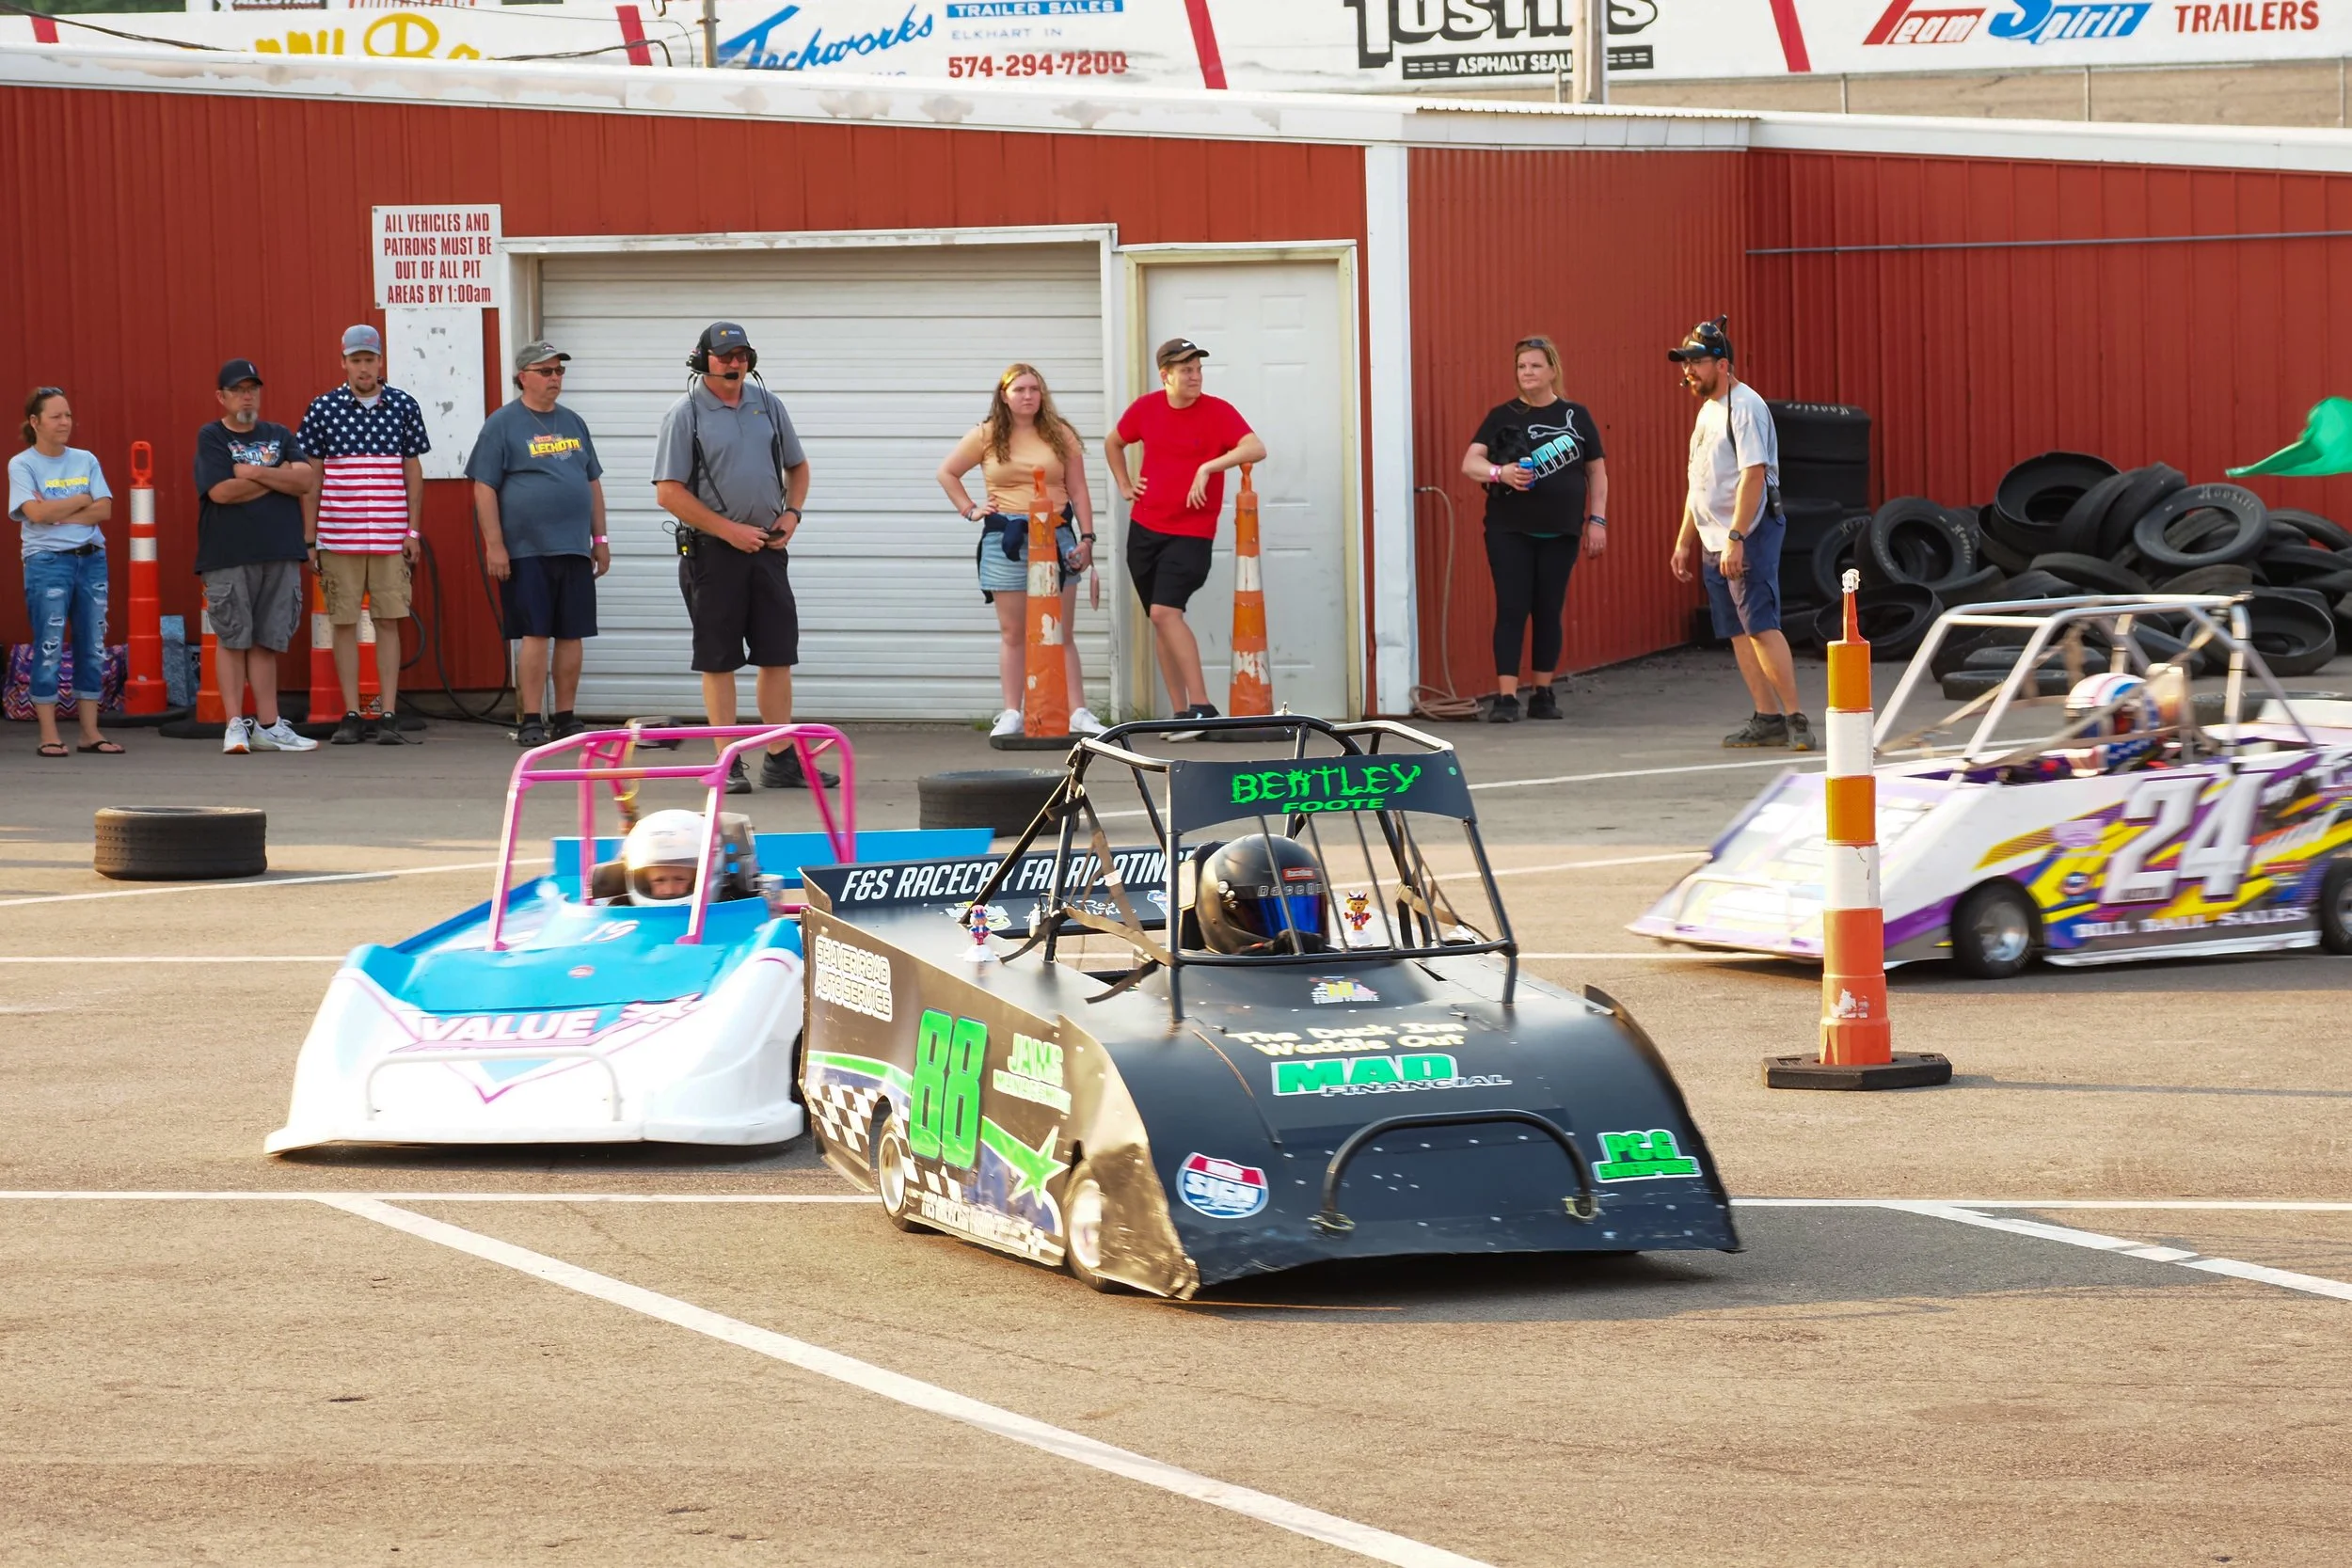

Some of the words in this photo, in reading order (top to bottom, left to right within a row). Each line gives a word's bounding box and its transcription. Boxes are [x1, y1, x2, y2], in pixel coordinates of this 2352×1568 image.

[955, 3, 1041, 17] TRAILER
[1048, 0, 1116, 14] SALES
[2174, 0, 2320, 35] TRAILERS
[951, 27, 1032, 40] ELKHART
[1043, 27, 1062, 38] IN
[948, 50, 1128, 79] 574-294-7200
[1456, 54, 1527, 74] ASPHALT
[385, 214, 404, 232] ALL
[407, 213, 461, 232] VEHICLES
[466, 213, 490, 232] AND
[384, 237, 437, 257] PATRONS
[441, 236, 473, 256] MUST
[478, 236, 492, 255] BE
[395, 261, 417, 279] OUT
[421, 261, 435, 279] OF
[439, 260, 458, 279] ALL
[463, 260, 482, 278] PIT
[388, 285, 424, 304] AREAS
[429, 284, 443, 303] BY
[448, 284, 491, 303] 1:00am
[1231, 764, 1422, 803] BENTLEY
[1282, 798, 1386, 813] FOOTE
[2100, 773, 2274, 903] 24
[840, 868, 894, 902] F&S
[421, 1009, 601, 1041] VALUE
[1225, 1031, 1302, 1043] The
[1307, 1023, 1399, 1038] Duck
[1252, 1037, 1391, 1055] Waddle
[1271, 1053, 1458, 1096] MAD
[909, 1007, 988, 1171] 88
[1321, 1074, 1512, 1097] FINANCIAL
